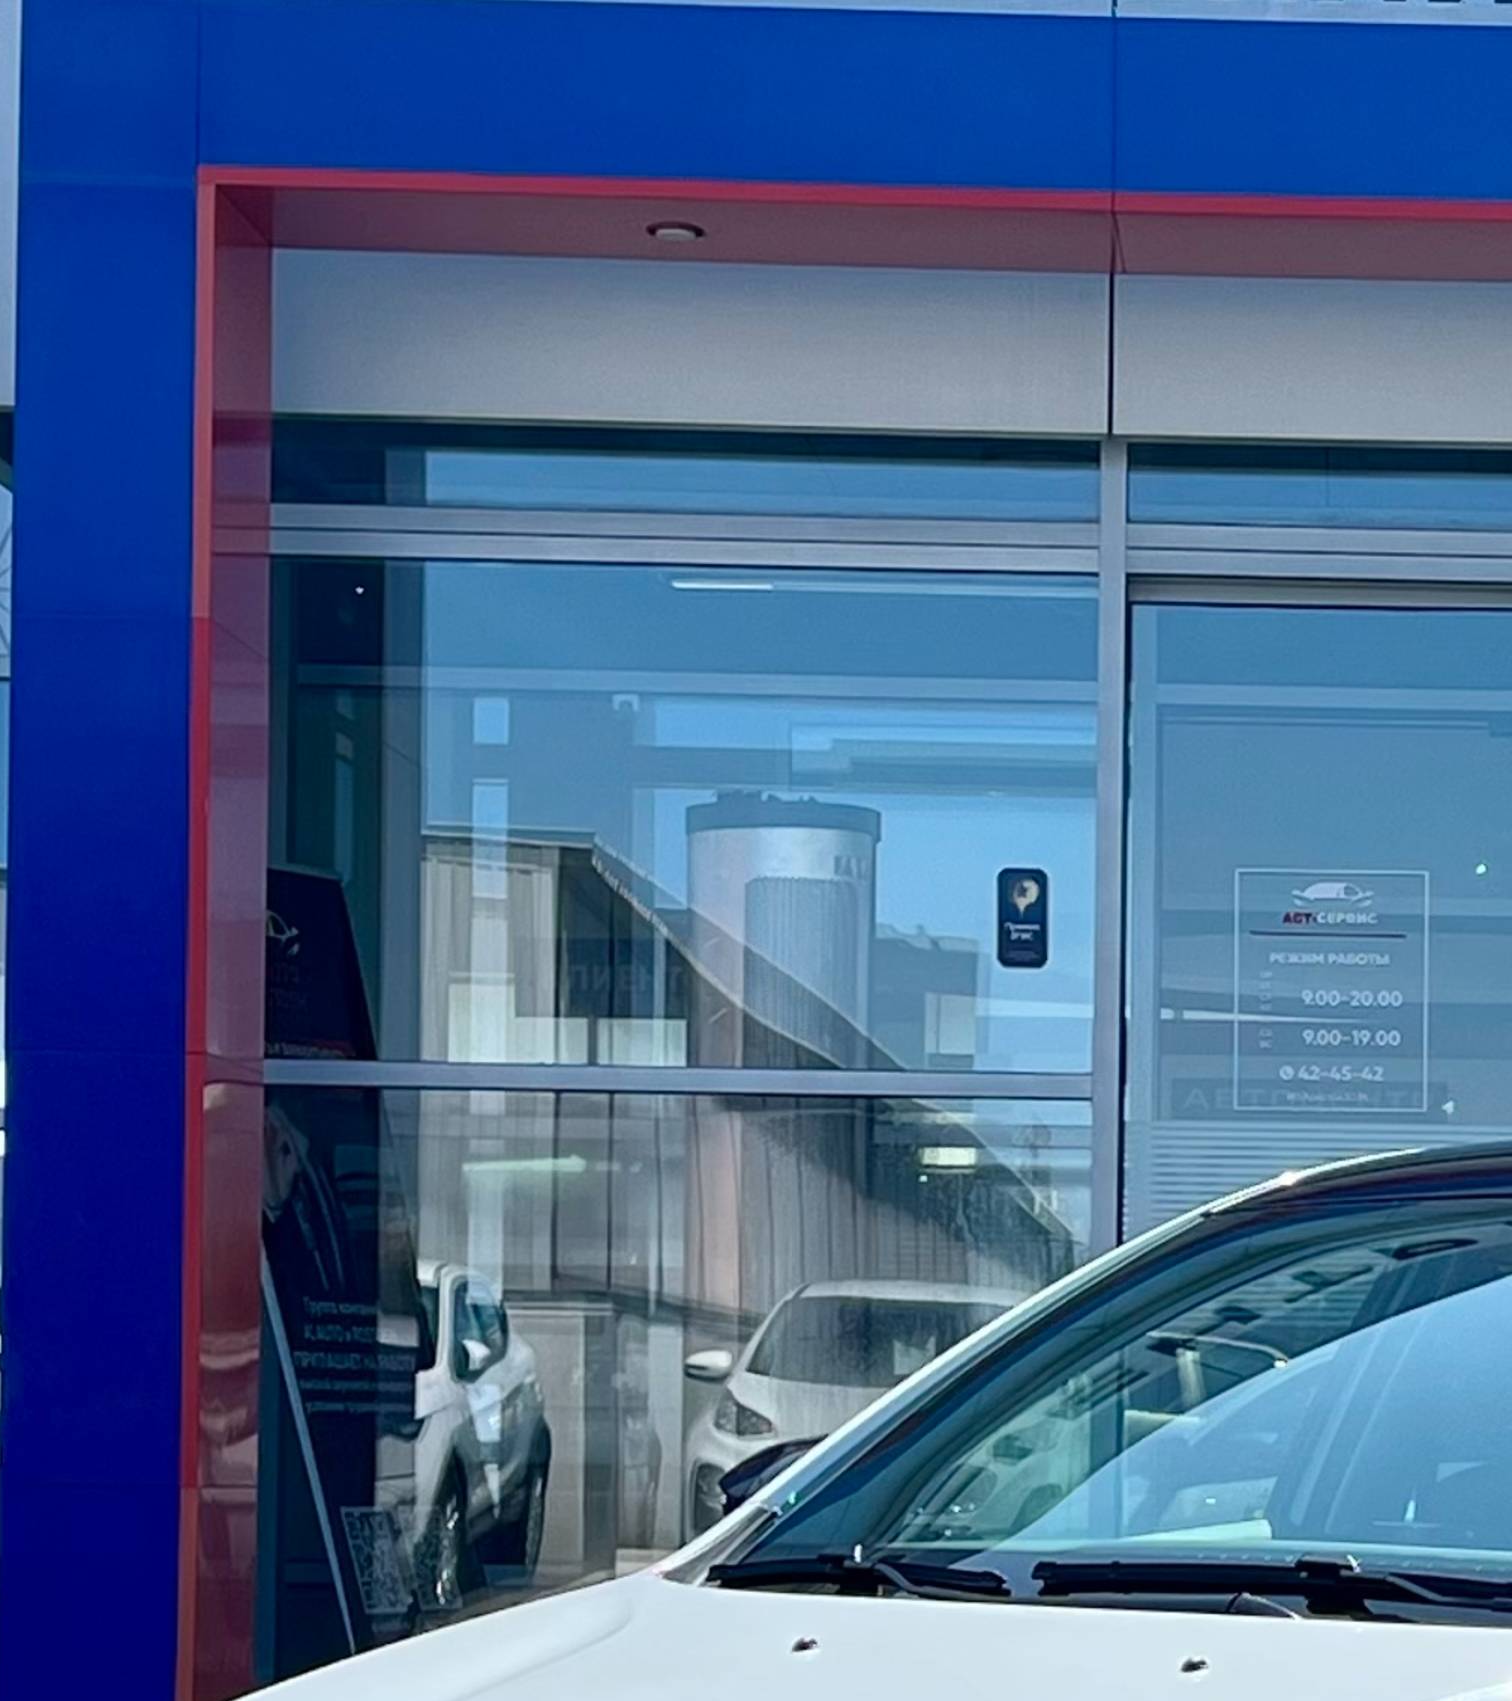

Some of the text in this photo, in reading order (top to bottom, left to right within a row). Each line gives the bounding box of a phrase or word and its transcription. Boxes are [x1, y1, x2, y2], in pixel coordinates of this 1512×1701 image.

[1269, 952, 1391, 965] РЕЖИМ РАБОТЫ
[1300, 989, 1403, 1007] 9.00-20.00
[1301, 1029, 1402, 1047] 9.00-19.00
[1297, 1065, 1385, 1082] 42-45-42
